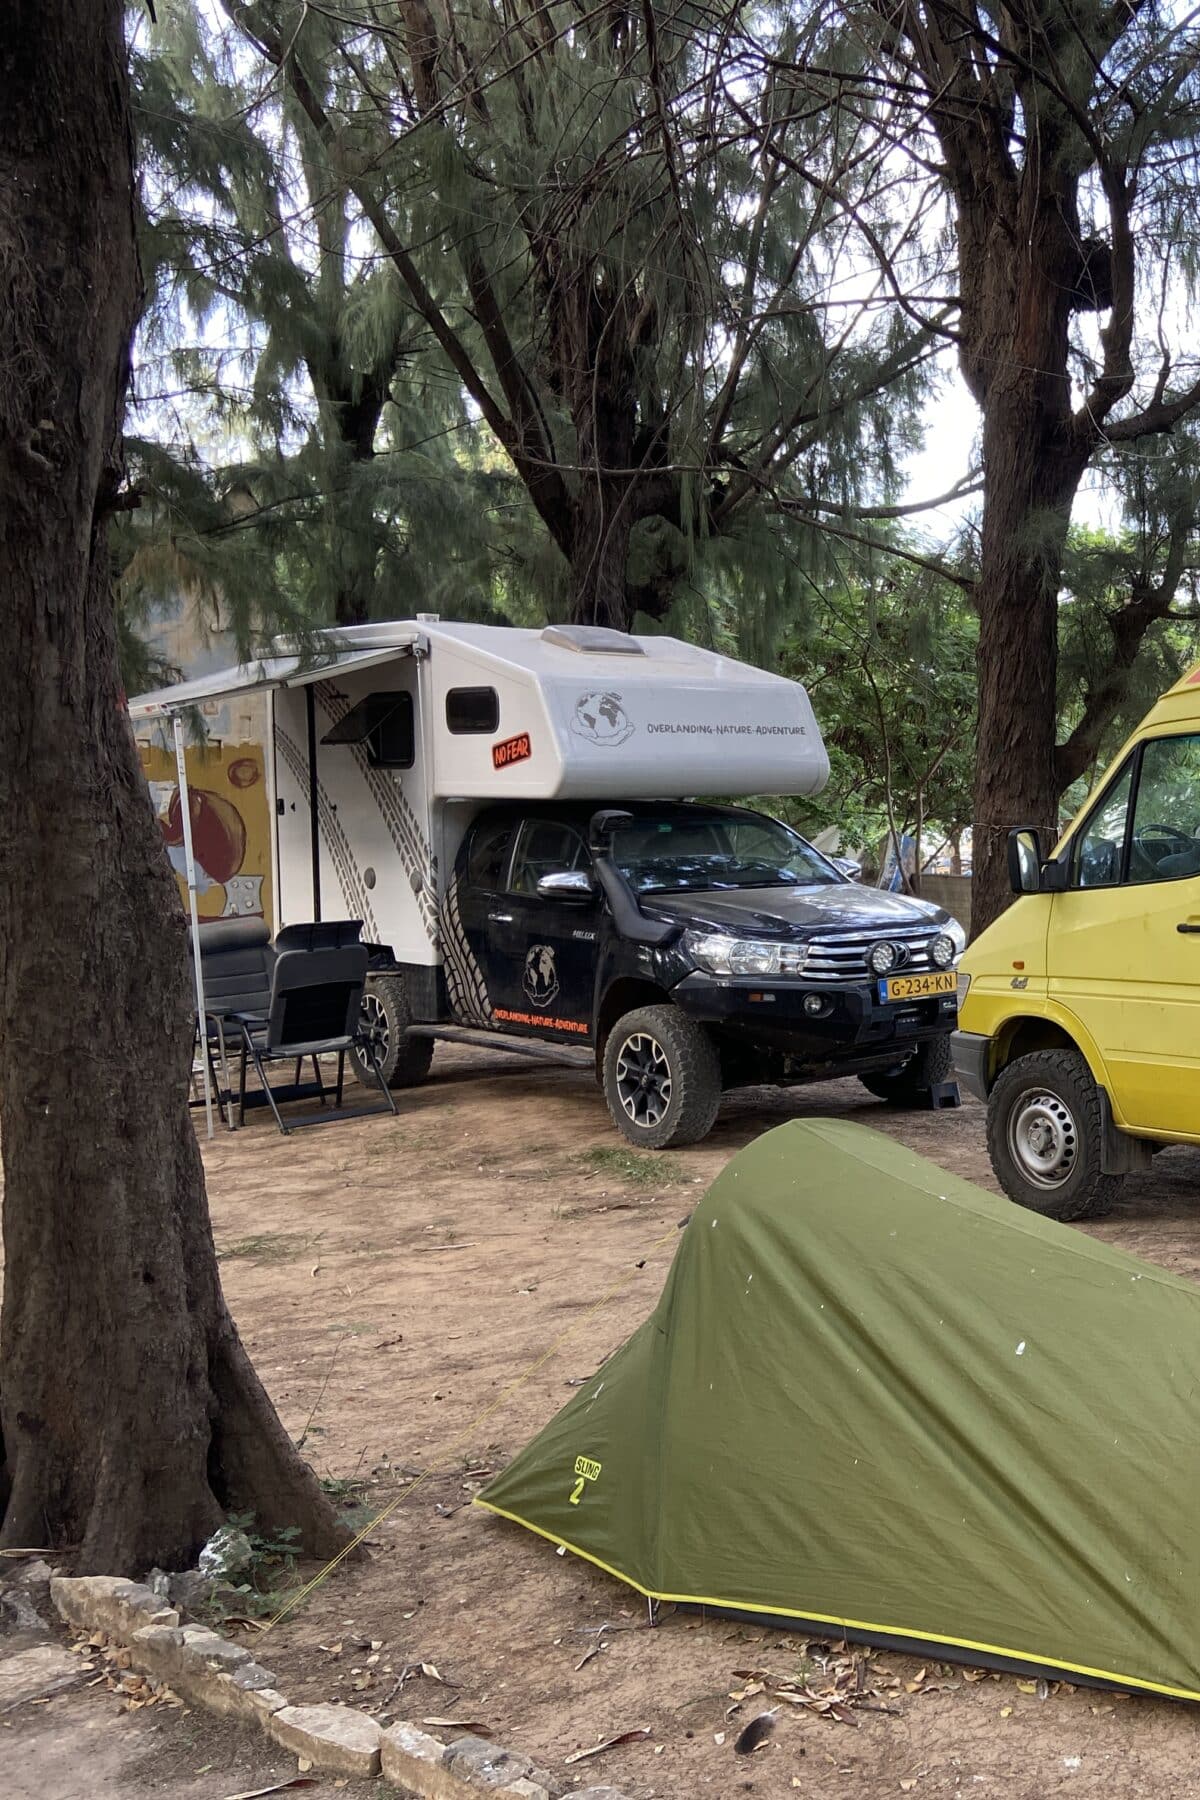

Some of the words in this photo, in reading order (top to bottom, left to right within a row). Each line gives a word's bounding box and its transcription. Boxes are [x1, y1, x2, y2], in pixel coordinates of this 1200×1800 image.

[647, 723, 806, 735] OVERLANDING-NATURE-ADVENTURE
[495, 745, 507, 764] NO
[507, 738, 529, 760] FEAR
[891, 975, 953, 995] G-234-KN
[575, 1457, 601, 1479] SLING
[569, 1477, 585, 1505] 2
